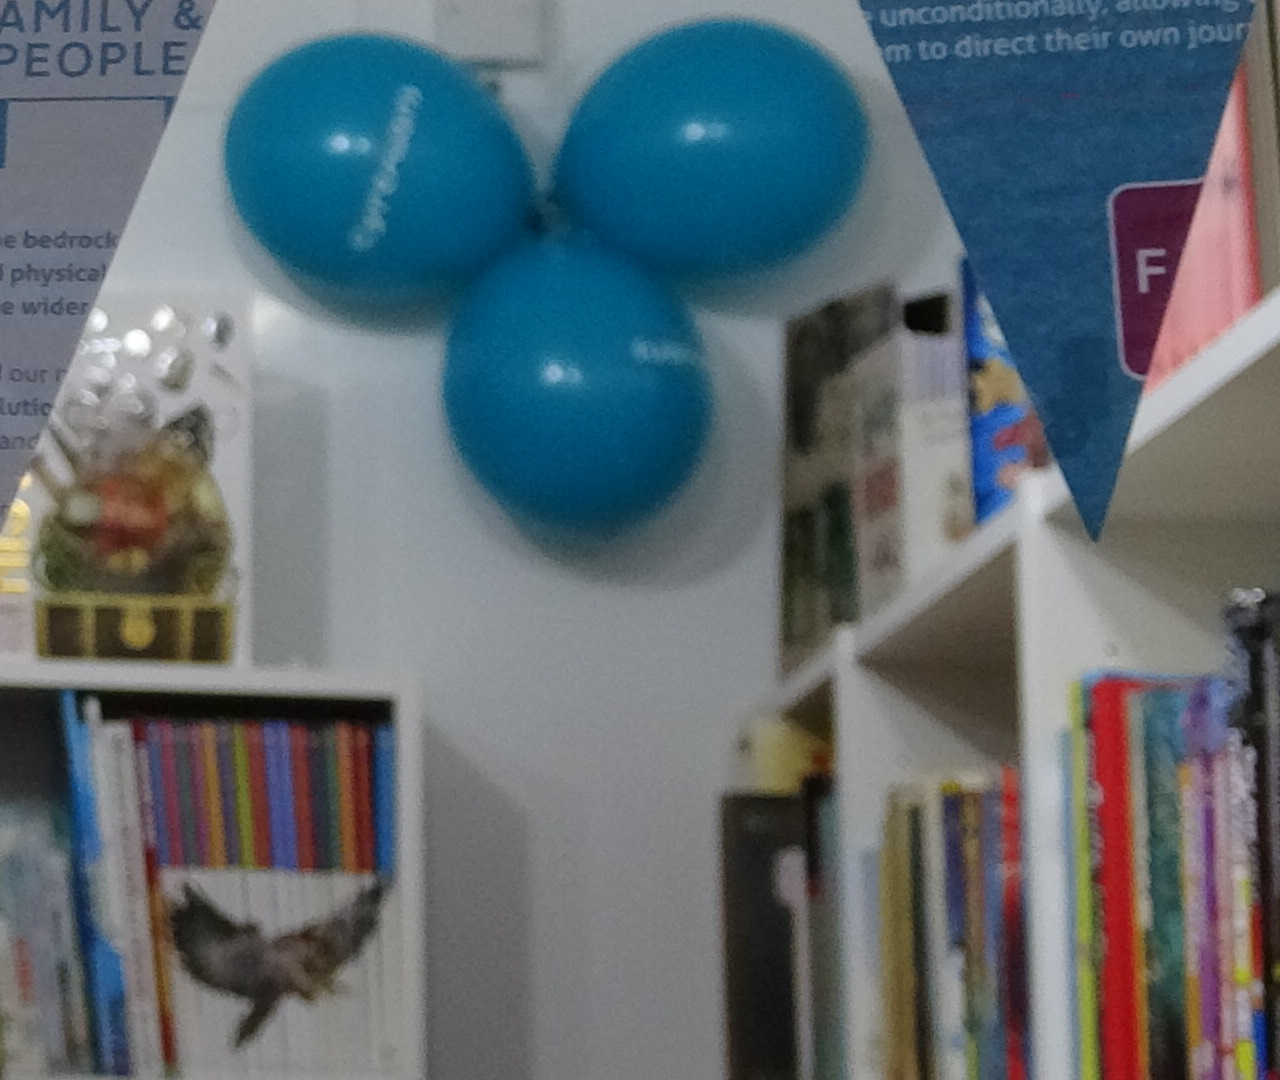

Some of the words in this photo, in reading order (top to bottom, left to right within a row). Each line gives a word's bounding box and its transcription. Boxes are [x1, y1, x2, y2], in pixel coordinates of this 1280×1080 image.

[919, 38, 947, 61] to
[954, 31, 1037, 59] direct
[1044, 25, 1111, 52] their
[1119, 27, 1181, 49] own
[1136, 248, 1168, 294] F
[21, 297, 89, 316] wider
[8, 366, 47, 383] our
